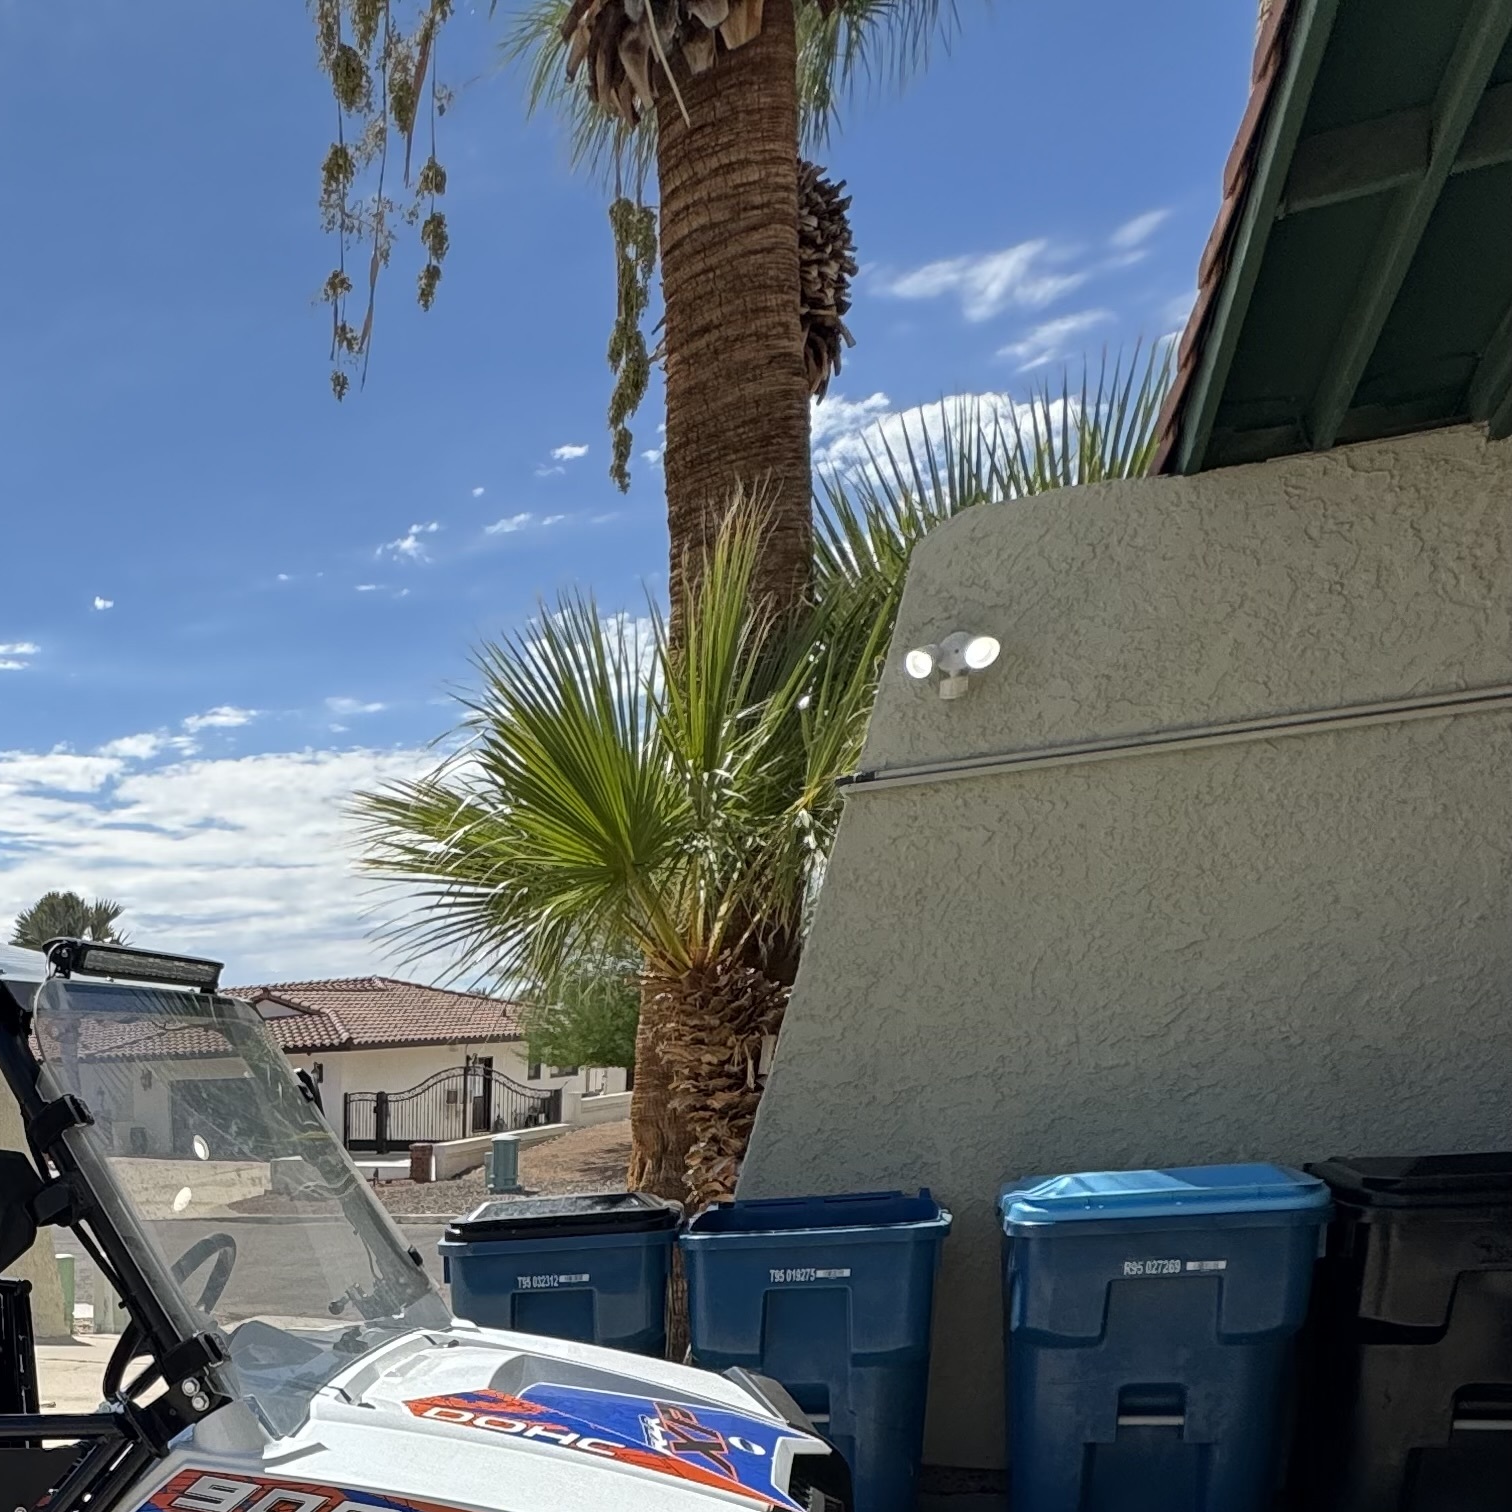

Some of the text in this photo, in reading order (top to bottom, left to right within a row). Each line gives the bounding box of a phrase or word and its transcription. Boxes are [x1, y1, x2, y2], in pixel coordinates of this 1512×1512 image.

[1123, 1259, 1181, 1275] R95 027269
[769, 1269, 785, 1282] T95
[420, 1406, 627, 1458] DOHC
